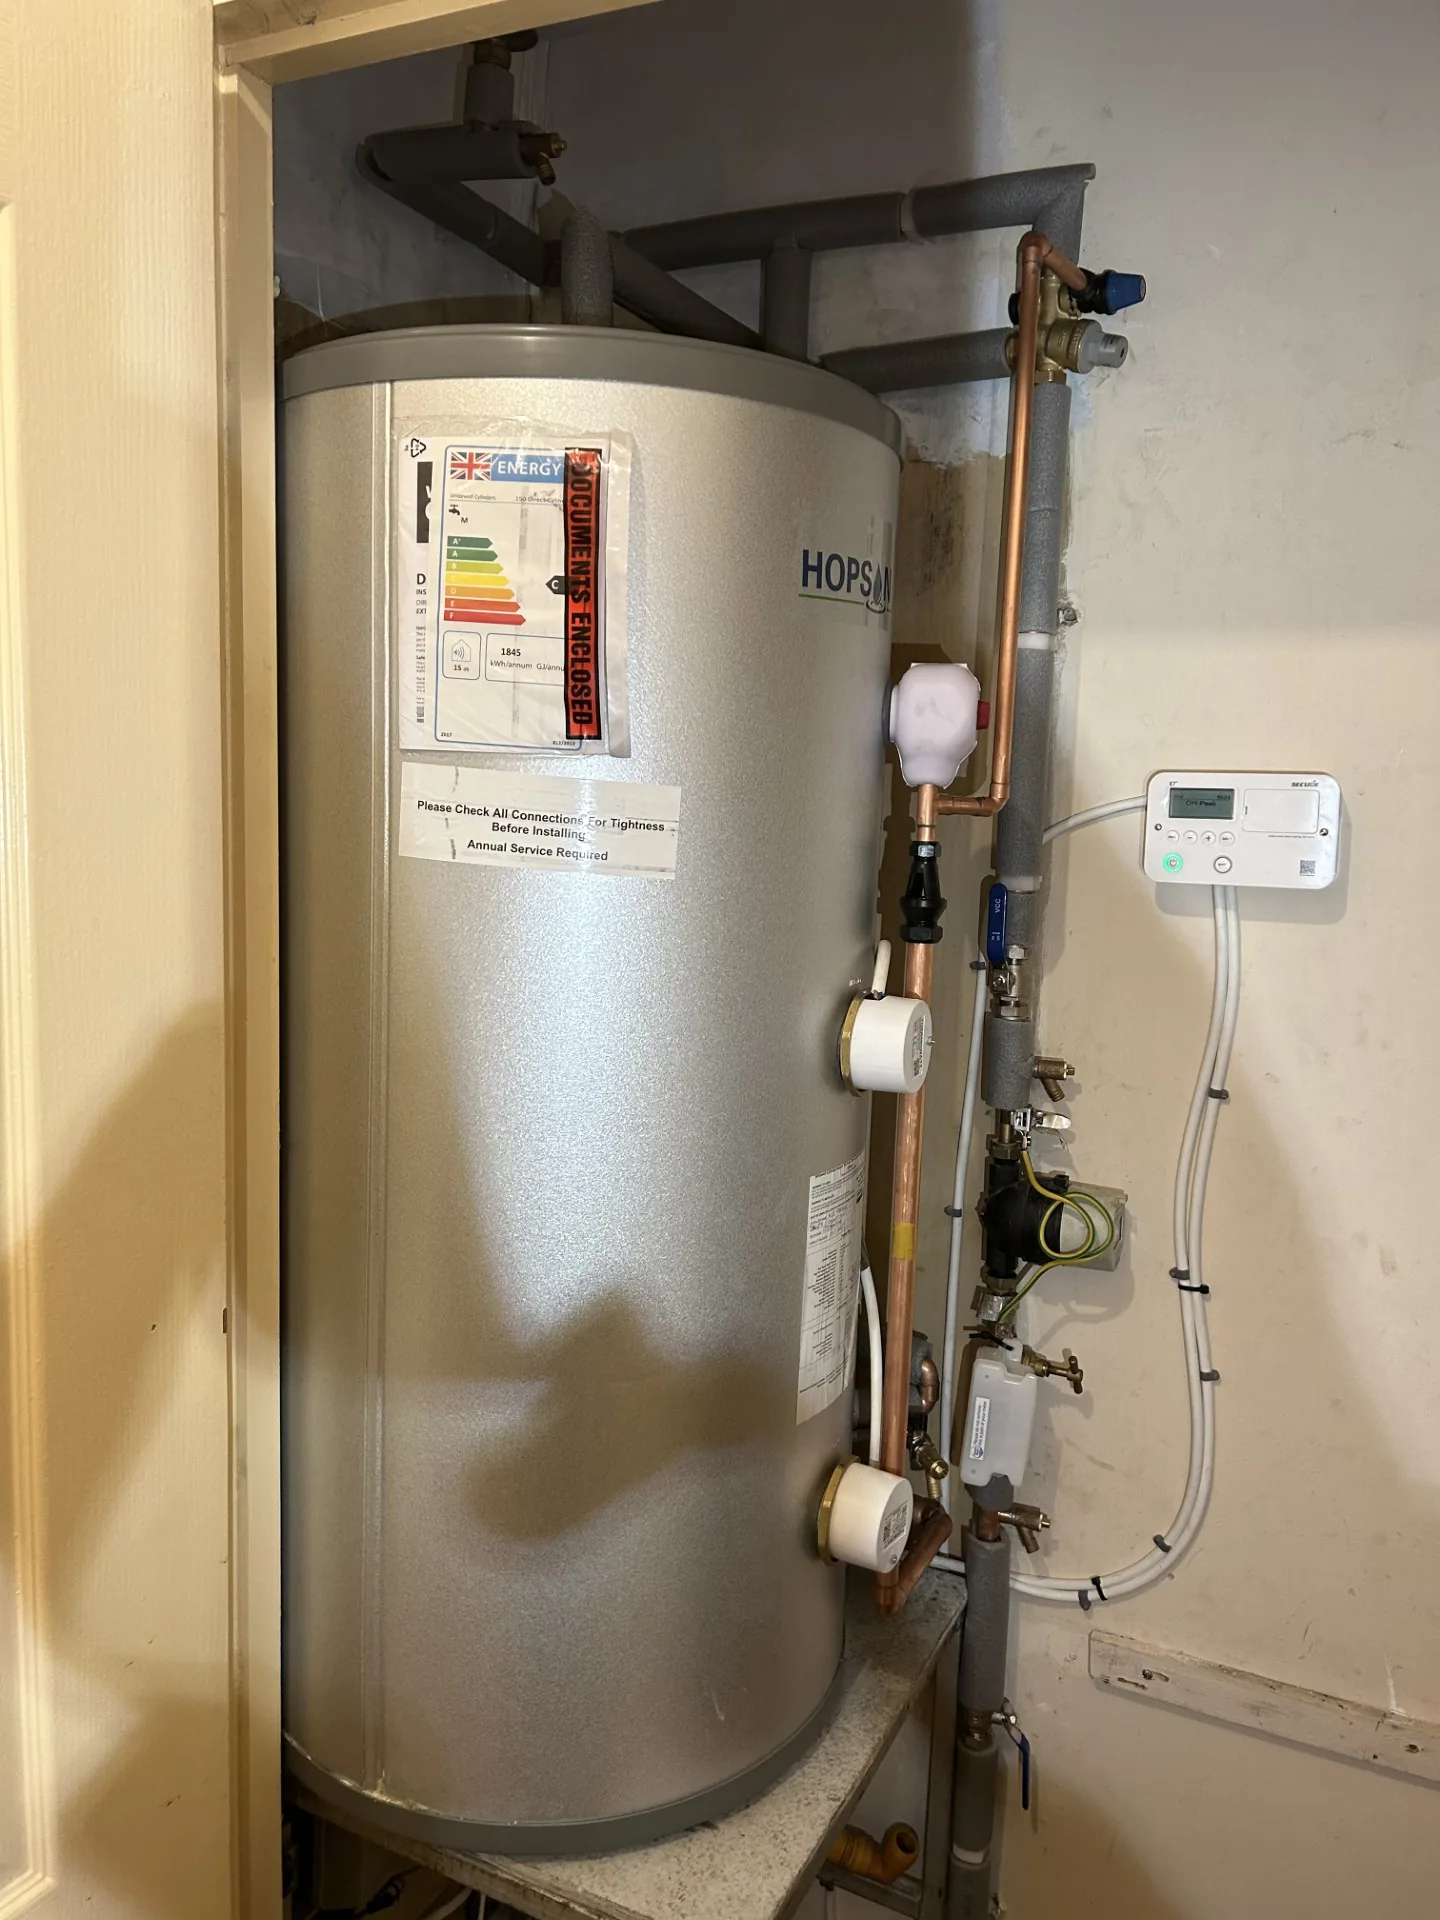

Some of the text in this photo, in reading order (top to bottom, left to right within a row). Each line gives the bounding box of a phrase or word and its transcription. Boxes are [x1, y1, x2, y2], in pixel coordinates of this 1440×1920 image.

[497, 460, 562, 476] ENERGY
[551, 580, 559, 589] C
[570, 463, 592, 724] DOCUMENTS ENCLOSED
[501, 648, 521, 657] 1845
[490, 660, 532, 669] kWh/annum
[418, 800, 664, 833] Please Check All Connections For Tightness
[492, 822, 585, 841] Before Installing
[467, 840, 608, 861] Annual Service Required
